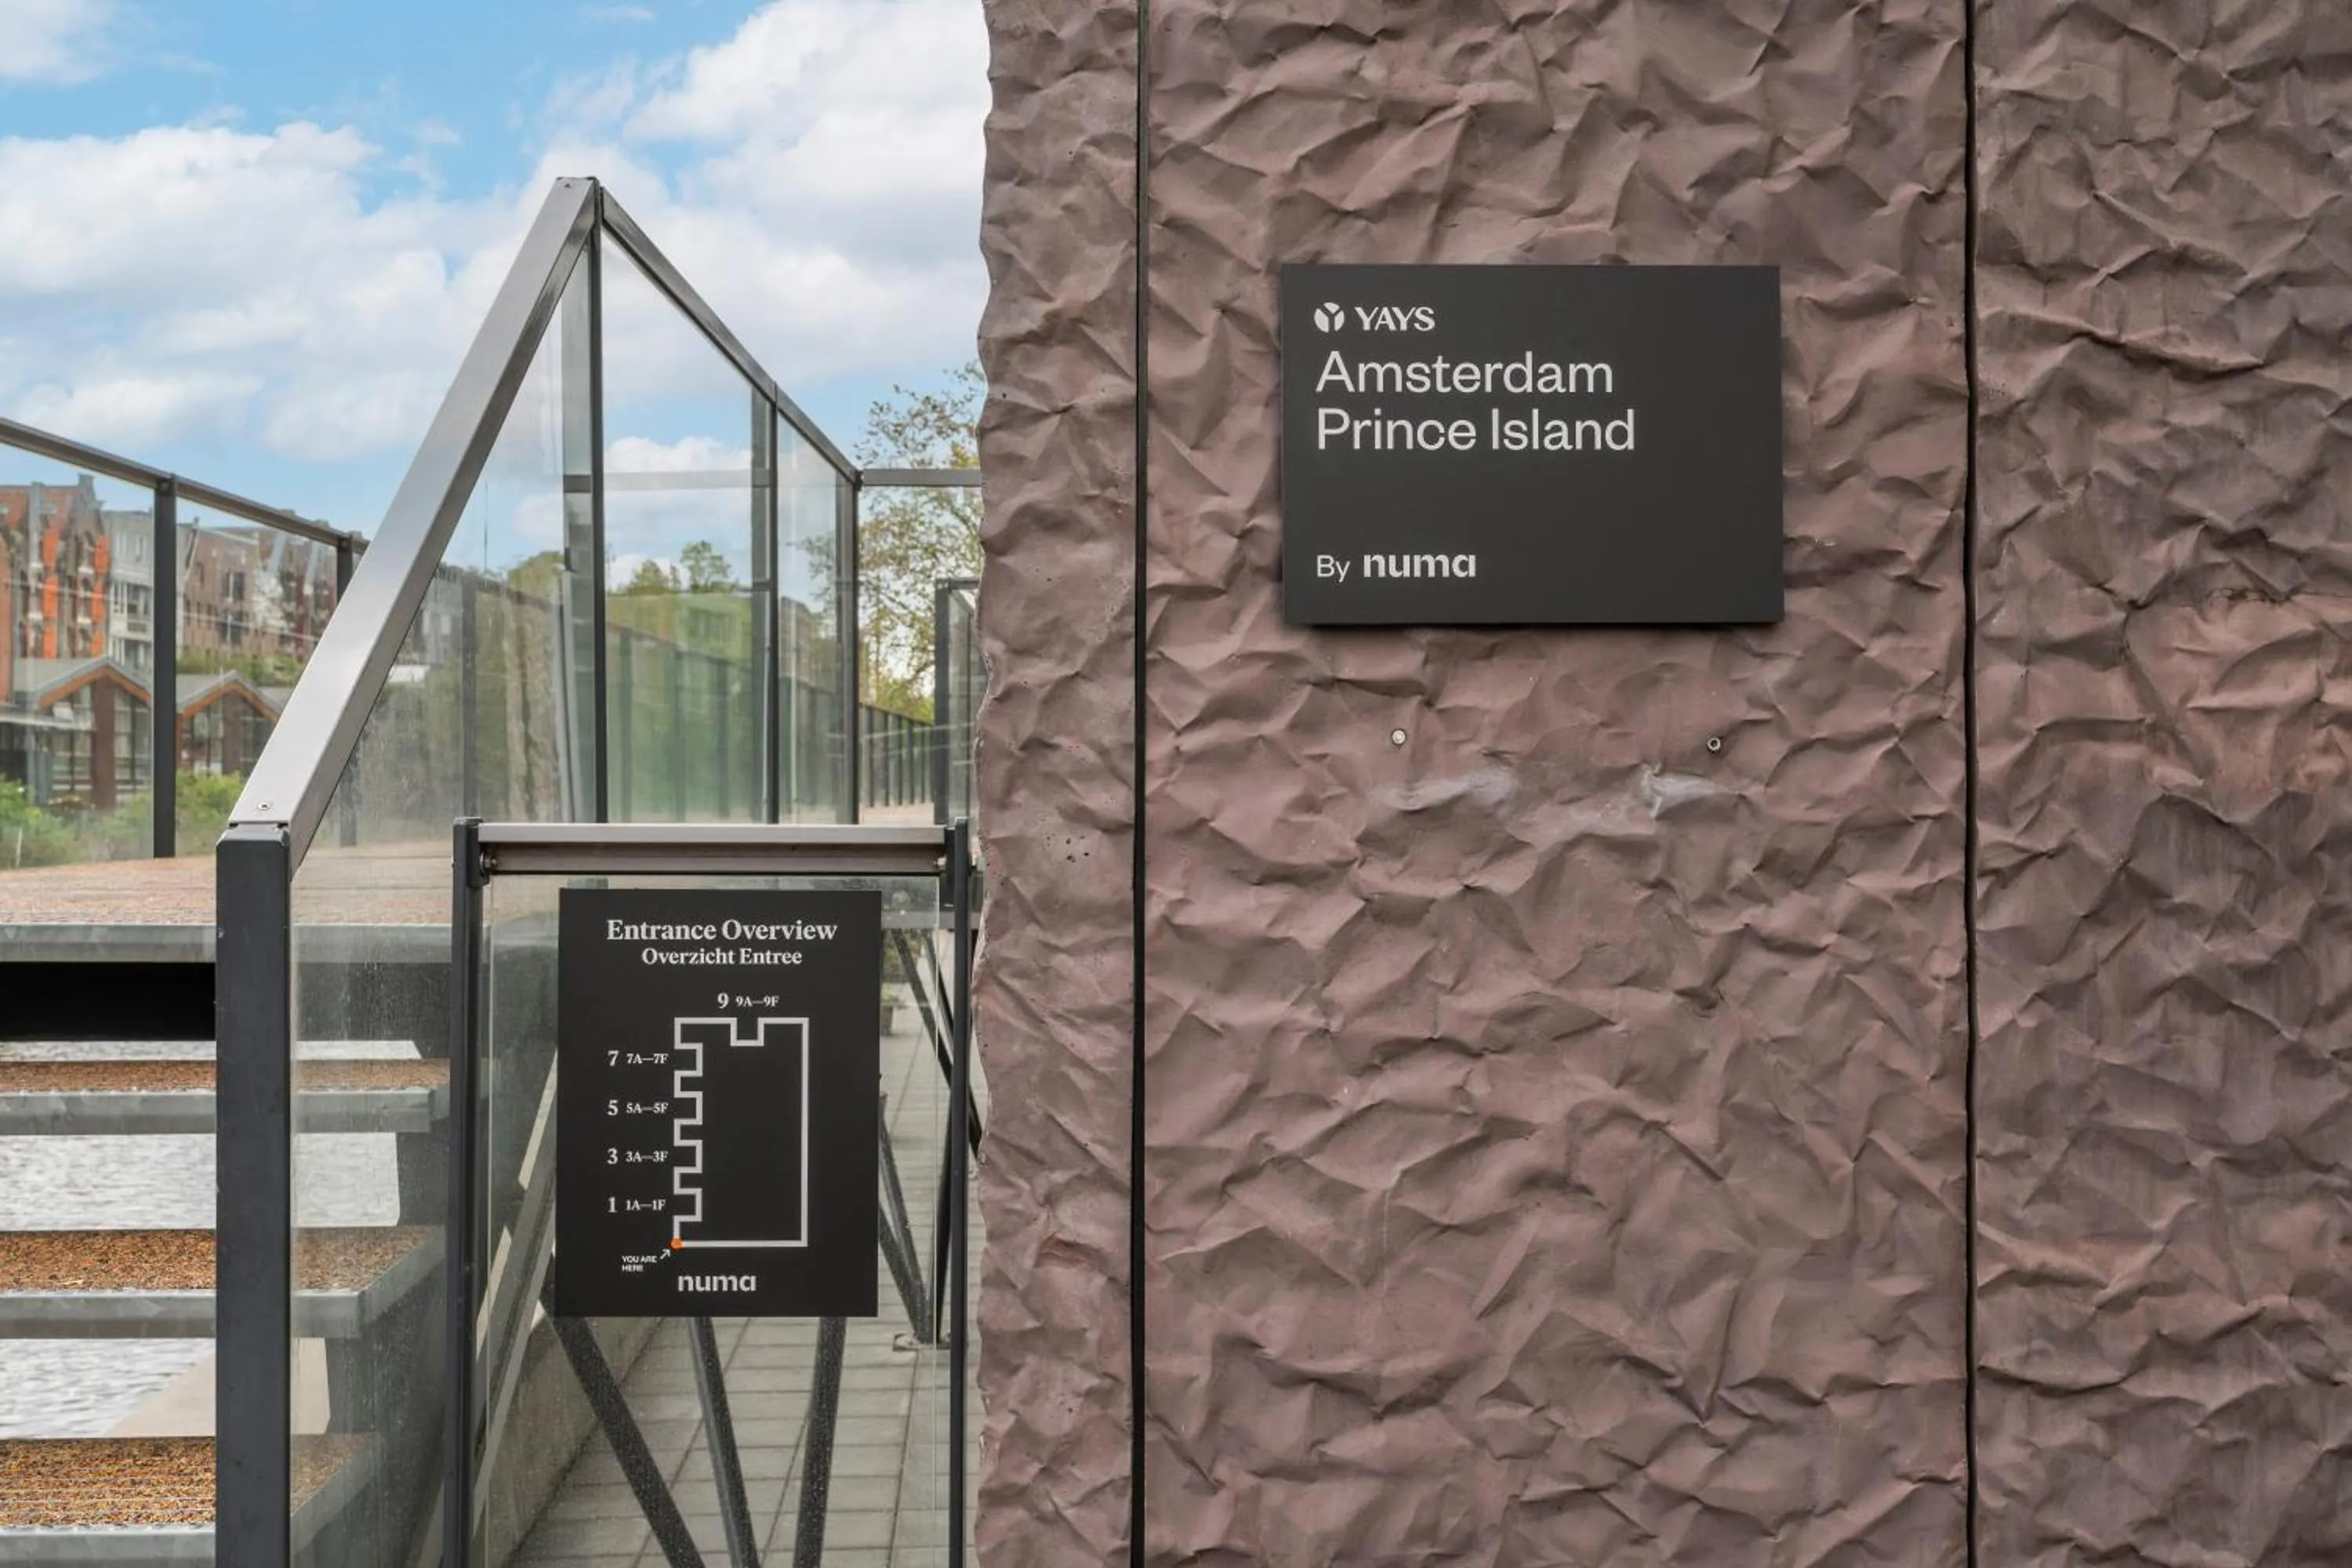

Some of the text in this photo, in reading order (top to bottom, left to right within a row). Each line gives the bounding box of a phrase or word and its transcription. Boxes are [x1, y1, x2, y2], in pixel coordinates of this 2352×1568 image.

[1354, 306, 1436, 332] YAYS
[1315, 350, 1613, 394] Amsterdam
[1318, 407, 1635, 451] Prince Island
[1316, 554, 1476, 583] By numa
[606, 919, 838, 940] Entrance Overview
[641, 947, 803, 965] Overzicht Entree
[717, 993, 729, 1009] 9
[608, 1050, 619, 1067] 7
[607, 1099, 619, 1116] 5
[607, 1147, 619, 1164] 3
[608, 1196, 616, 1213] 1
[678, 1275, 757, 1292] numa
